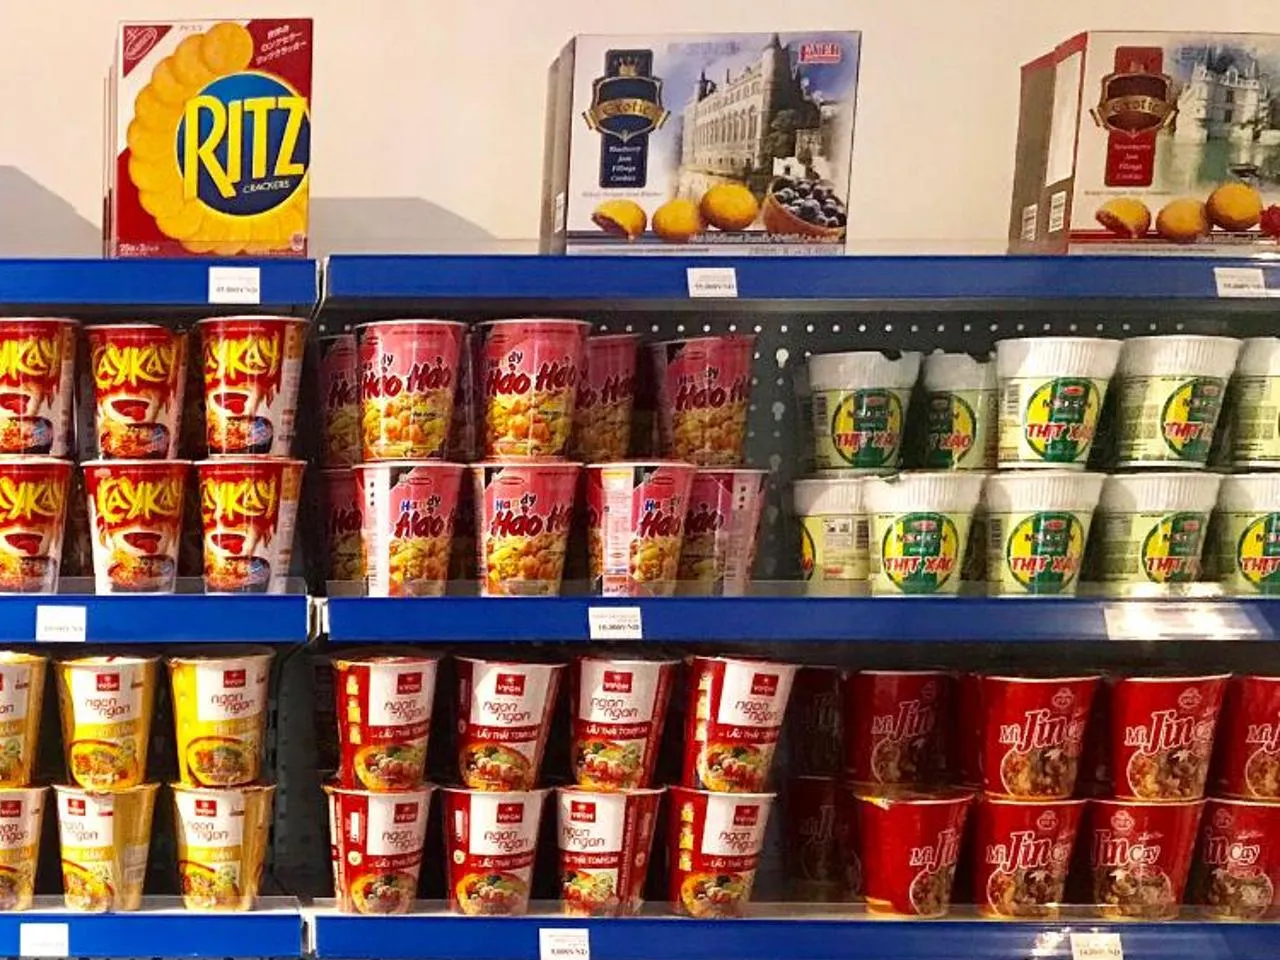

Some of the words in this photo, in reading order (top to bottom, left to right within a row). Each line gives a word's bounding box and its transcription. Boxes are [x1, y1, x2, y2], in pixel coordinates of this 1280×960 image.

[185, 96, 309, 199] RITZ
[243, 180, 290, 195] CRACKERS
[483, 700, 517, 715] ngon
[603, 707, 638, 721] ngon
[496, 708, 532, 724] ngon
[1014, 708, 1067, 754] Jin
[1140, 710, 1195, 756] Jin
[573, 836, 606, 850] ngon
[1001, 830, 1052, 874] Jin
